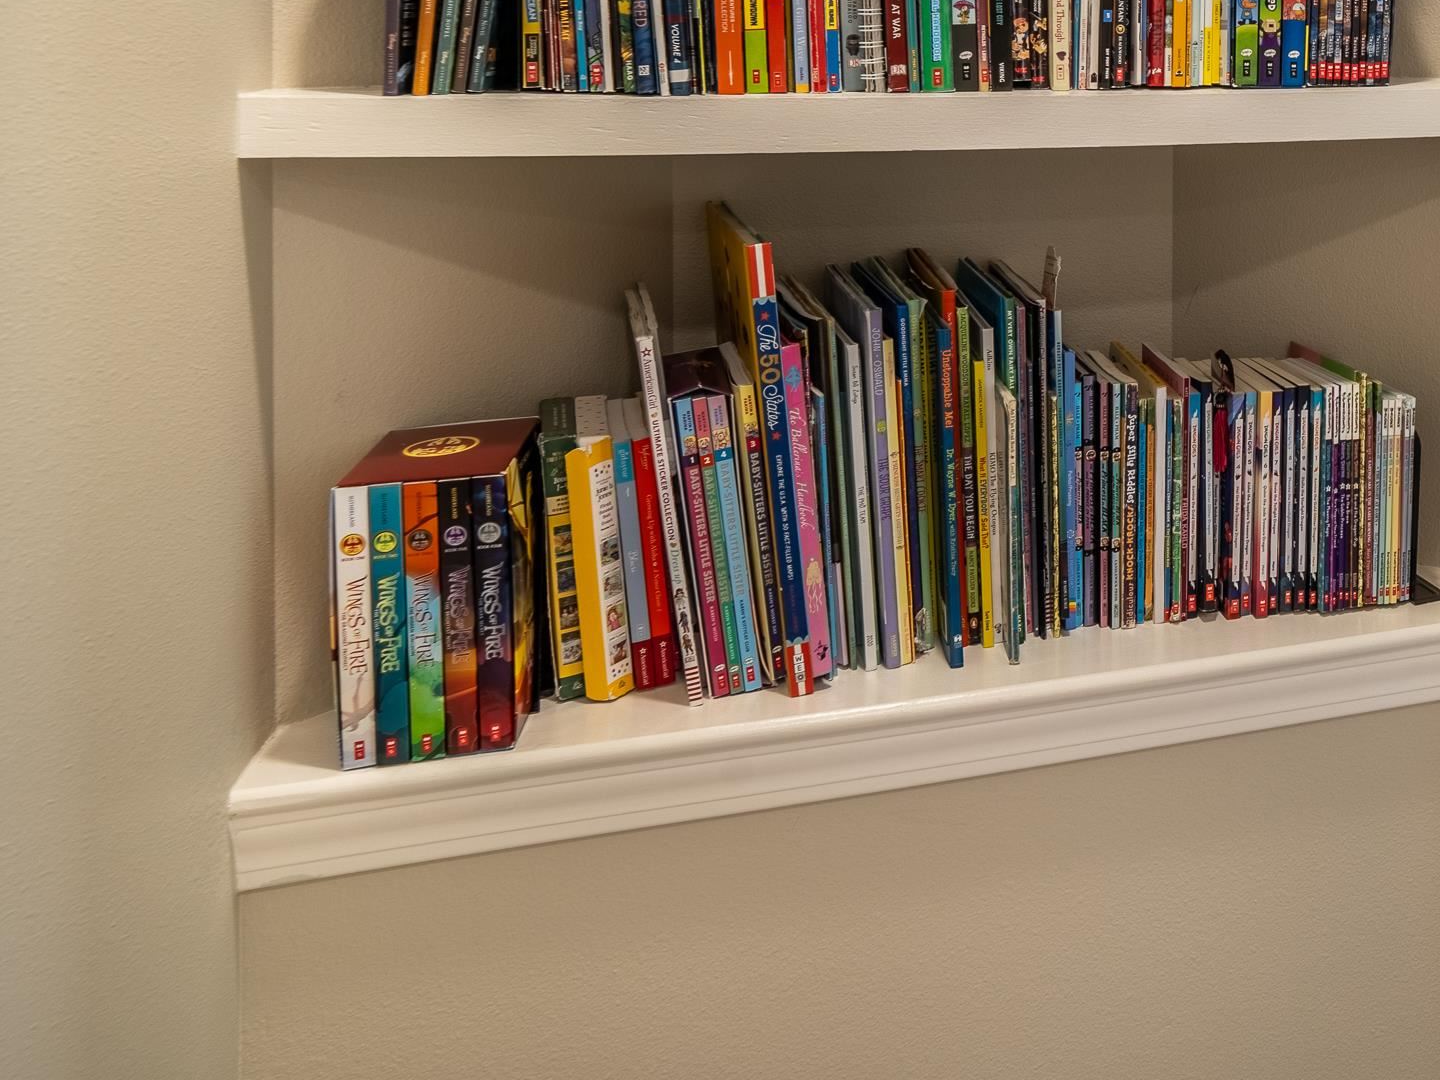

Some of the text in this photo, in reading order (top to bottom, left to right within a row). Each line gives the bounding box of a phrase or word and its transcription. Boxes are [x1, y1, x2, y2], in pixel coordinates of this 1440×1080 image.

[892, 5, 900, 14] AT
[1055, 9, 1064, 43] Through
[671, 24, 679, 57] VOLUME
[892, 19, 901, 39] WAR
[759, 354, 781, 384] 50
[941, 349, 952, 408] Unstoppable
[652, 420, 676, 541] ULTIMATE STICKER COLLECTION
[750, 453, 768, 520] BABY-SITTERS
[964, 456, 975, 539] THE DAY YOU BEGIN
[689, 469, 708, 537] BABY-SITTERS
[699, 539, 711, 569] LITTLE
[758, 522, 770, 551] LITTLE
[345, 576, 367, 627] WINGS
[377, 573, 401, 625] WINGS
[480, 562, 504, 613] WINGS
[703, 571, 715, 603] SISTER
[379, 636, 402, 673] FIRE
[484, 624, 505, 660] FIRE
